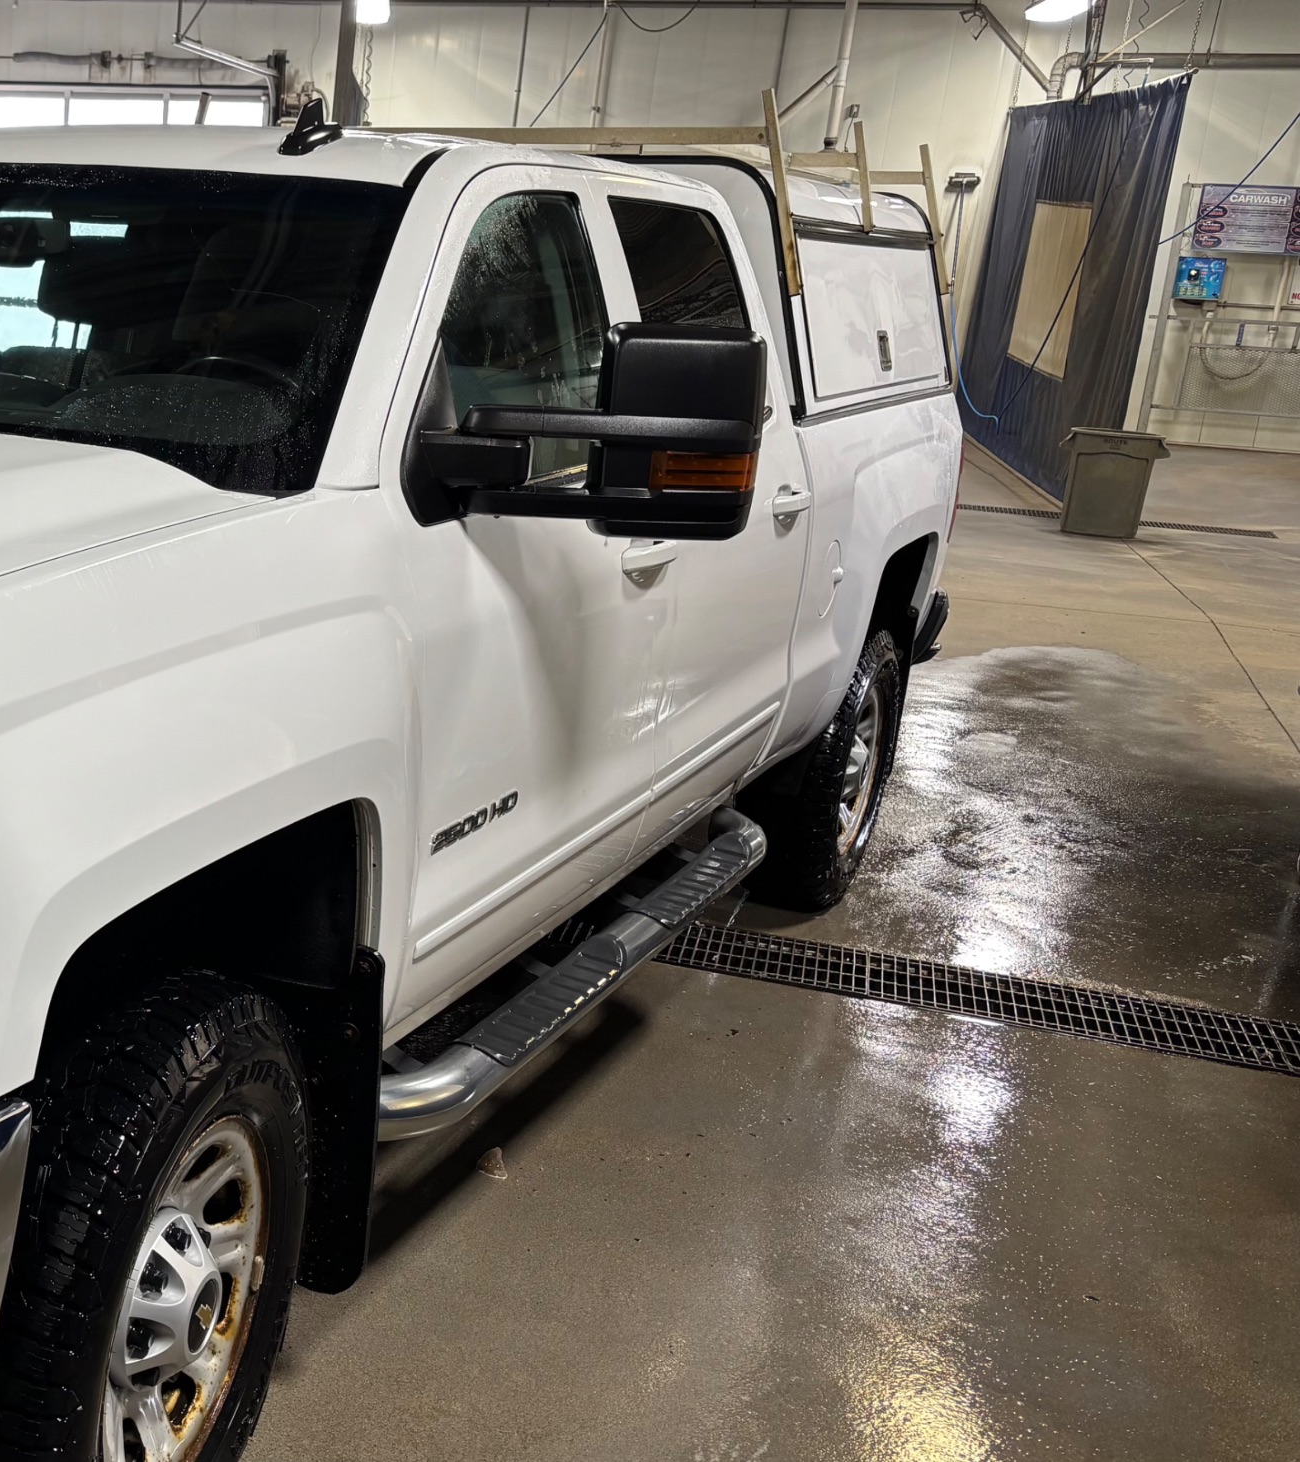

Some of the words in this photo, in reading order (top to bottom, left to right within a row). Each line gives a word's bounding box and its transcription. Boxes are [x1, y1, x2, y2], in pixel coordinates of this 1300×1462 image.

[1229, 194, 1288, 205] CARWASH
[430, 805, 488, 856] 2500
[488, 789, 519, 823] HD
